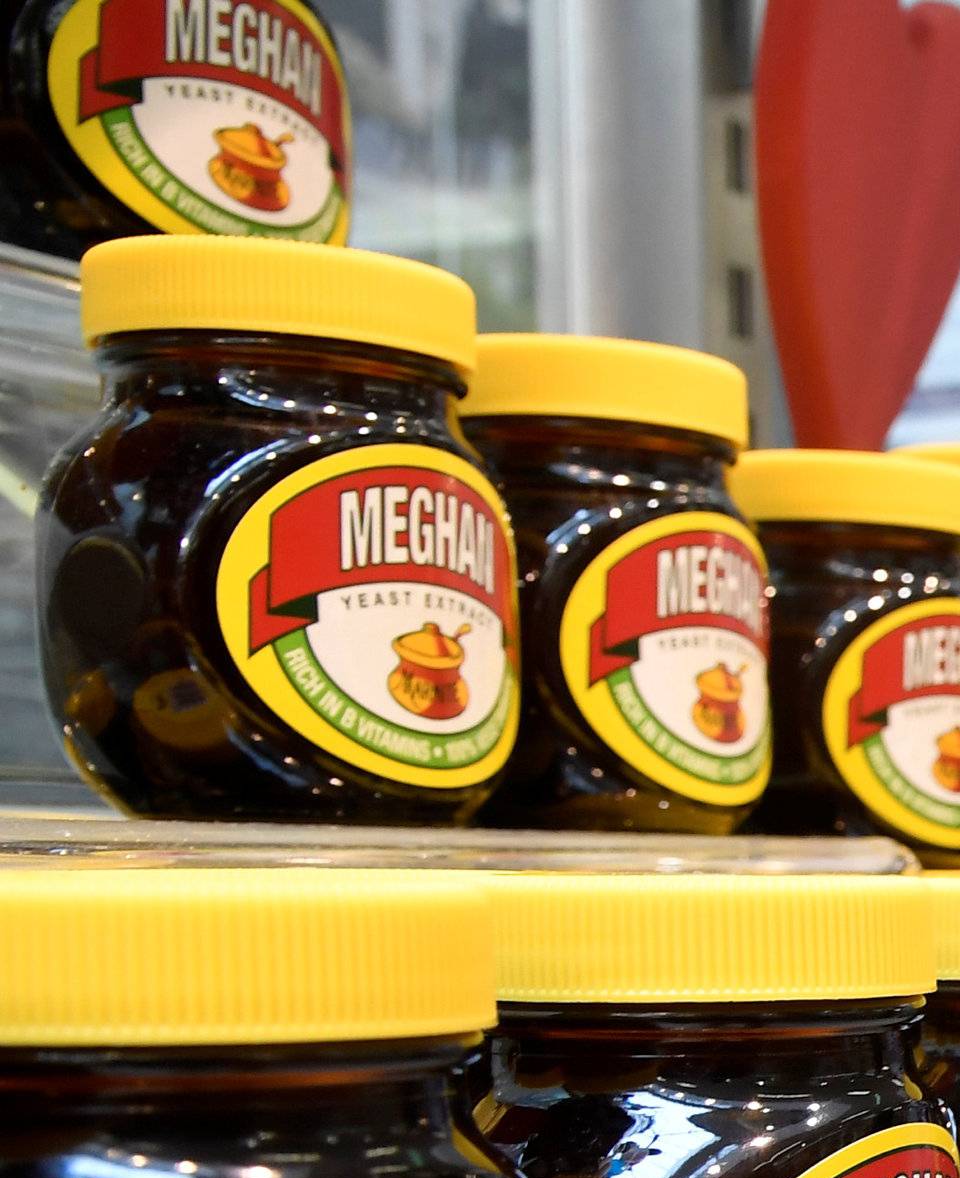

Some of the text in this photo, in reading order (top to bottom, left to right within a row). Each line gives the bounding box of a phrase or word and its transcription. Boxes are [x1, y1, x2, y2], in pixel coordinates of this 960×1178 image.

[163, 83, 234, 103] YEAST
[166, 0, 321, 118] MEGHAN
[340, 485, 495, 595] MEGHAN
[340, 590, 494, 629] YEAST EXTRACT
[284, 647, 326, 698] RICH
[318, 692, 346, 720] IN
